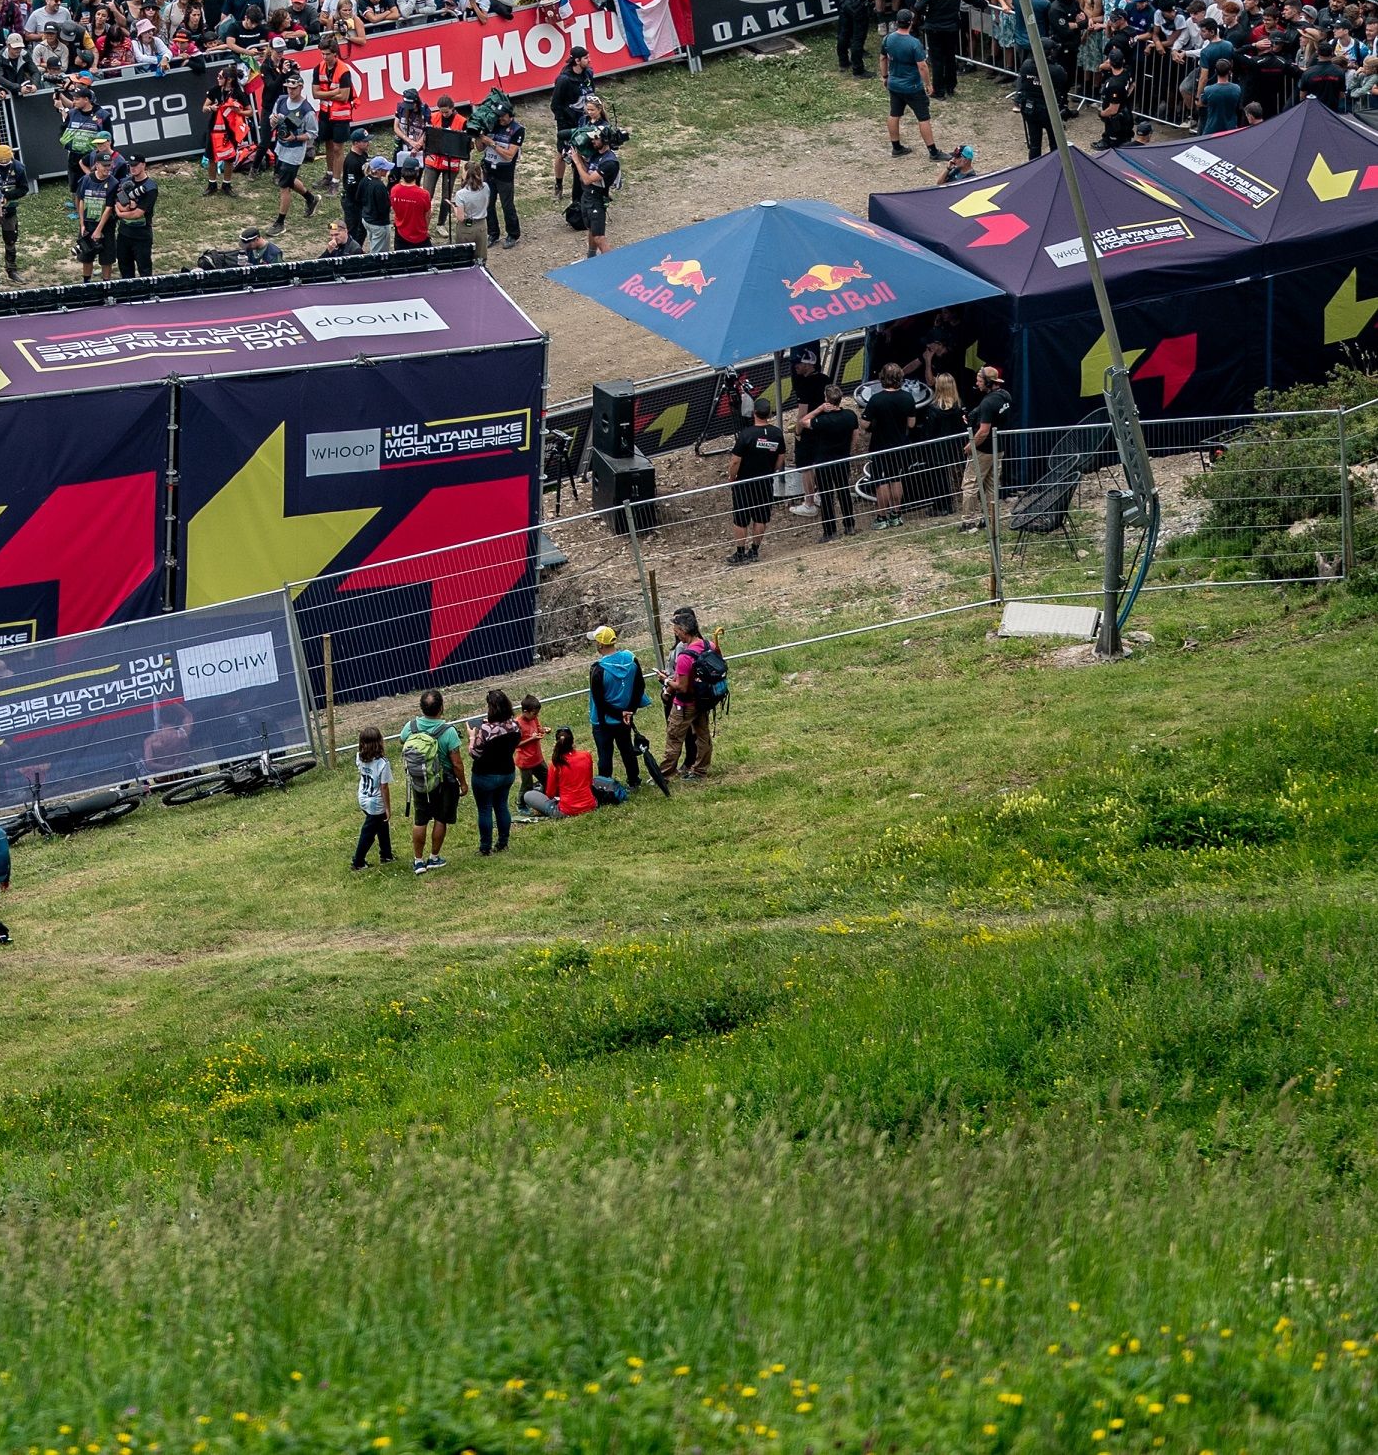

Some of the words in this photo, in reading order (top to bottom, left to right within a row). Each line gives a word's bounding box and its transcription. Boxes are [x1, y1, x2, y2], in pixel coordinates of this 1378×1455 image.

[480, 9, 626, 82] MOTU
[101, 93, 187, 120] oPro
[1183, 151, 1210, 168] WHOOP
[1206, 169, 1234, 188] WORLD
[1232, 185, 1264, 203] SERIES
[1212, 163, 1252, 189] MOUNTAIN
[1250, 185, 1270, 199] BIKE
[1097, 228, 1116, 239] UCI
[1097, 228, 1155, 247] MOUNTAIN
[1155, 223, 1182, 235] BIKE
[1100, 237, 1144, 251] WORLD
[1145, 230, 1186, 243] SERIES
[1053, 245, 1086, 260] WHOO
[618, 273, 662, 303] Red
[650, 288, 697, 320] Bull
[788, 292, 842, 325] Red
[842, 281, 897, 313] Bull
[315, 311, 429, 327] WHOOP
[384, 429, 478, 449] MOUNTAIN
[481, 421, 522, 436] BIKE
[392, 423, 419, 438] UCI
[311, 443, 375, 461] WHOOP
[384, 440, 455, 458] WORLD
[457, 433, 522, 452] SERIES
